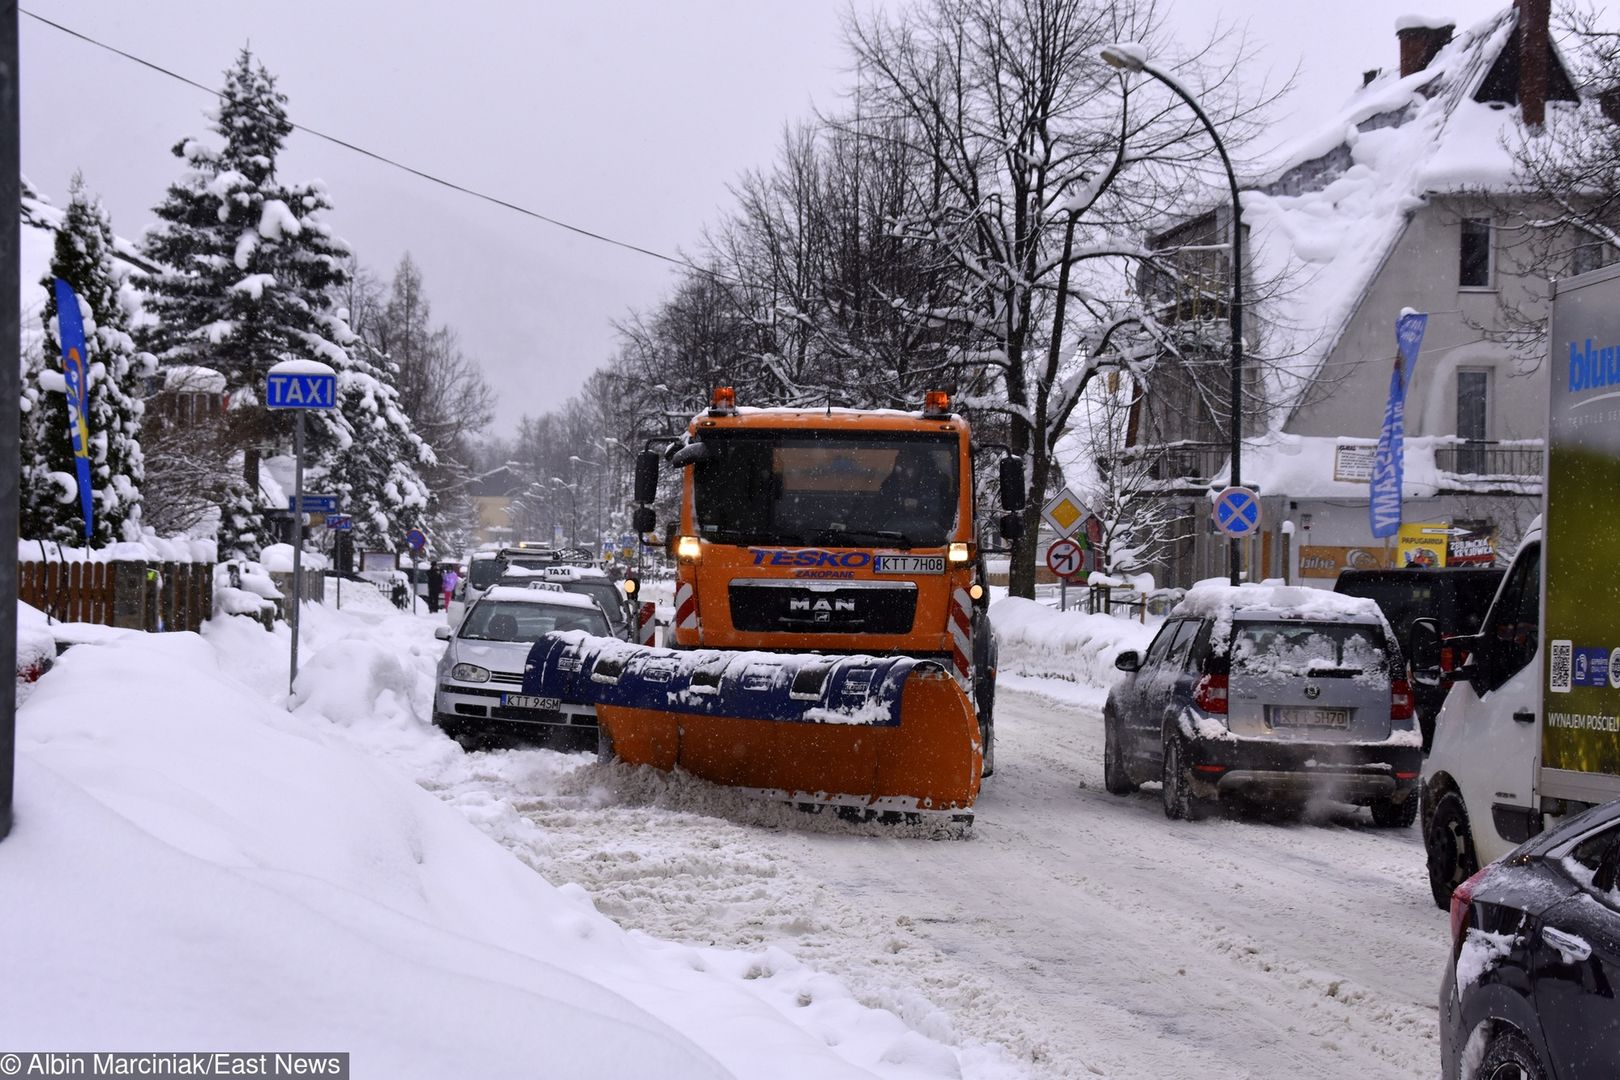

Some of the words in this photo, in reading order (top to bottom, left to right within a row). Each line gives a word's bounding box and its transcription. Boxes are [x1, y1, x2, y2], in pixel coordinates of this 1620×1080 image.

[269, 377, 332, 404] TAXI
[750, 550, 871, 567] TESKO
[882, 558, 908, 571] KTT
[912, 559, 943, 572] 7H08
[548, 568, 570, 576] TAXI
[795, 570, 855, 579] ZAKOPANE
[532, 583, 560, 592] TAXI
[790, 598, 855, 611] MAN
[507, 695, 530, 707] KTT
[533, 697, 559, 709] 94SM
[1548, 712, 1586, 729] WYNAJEM
